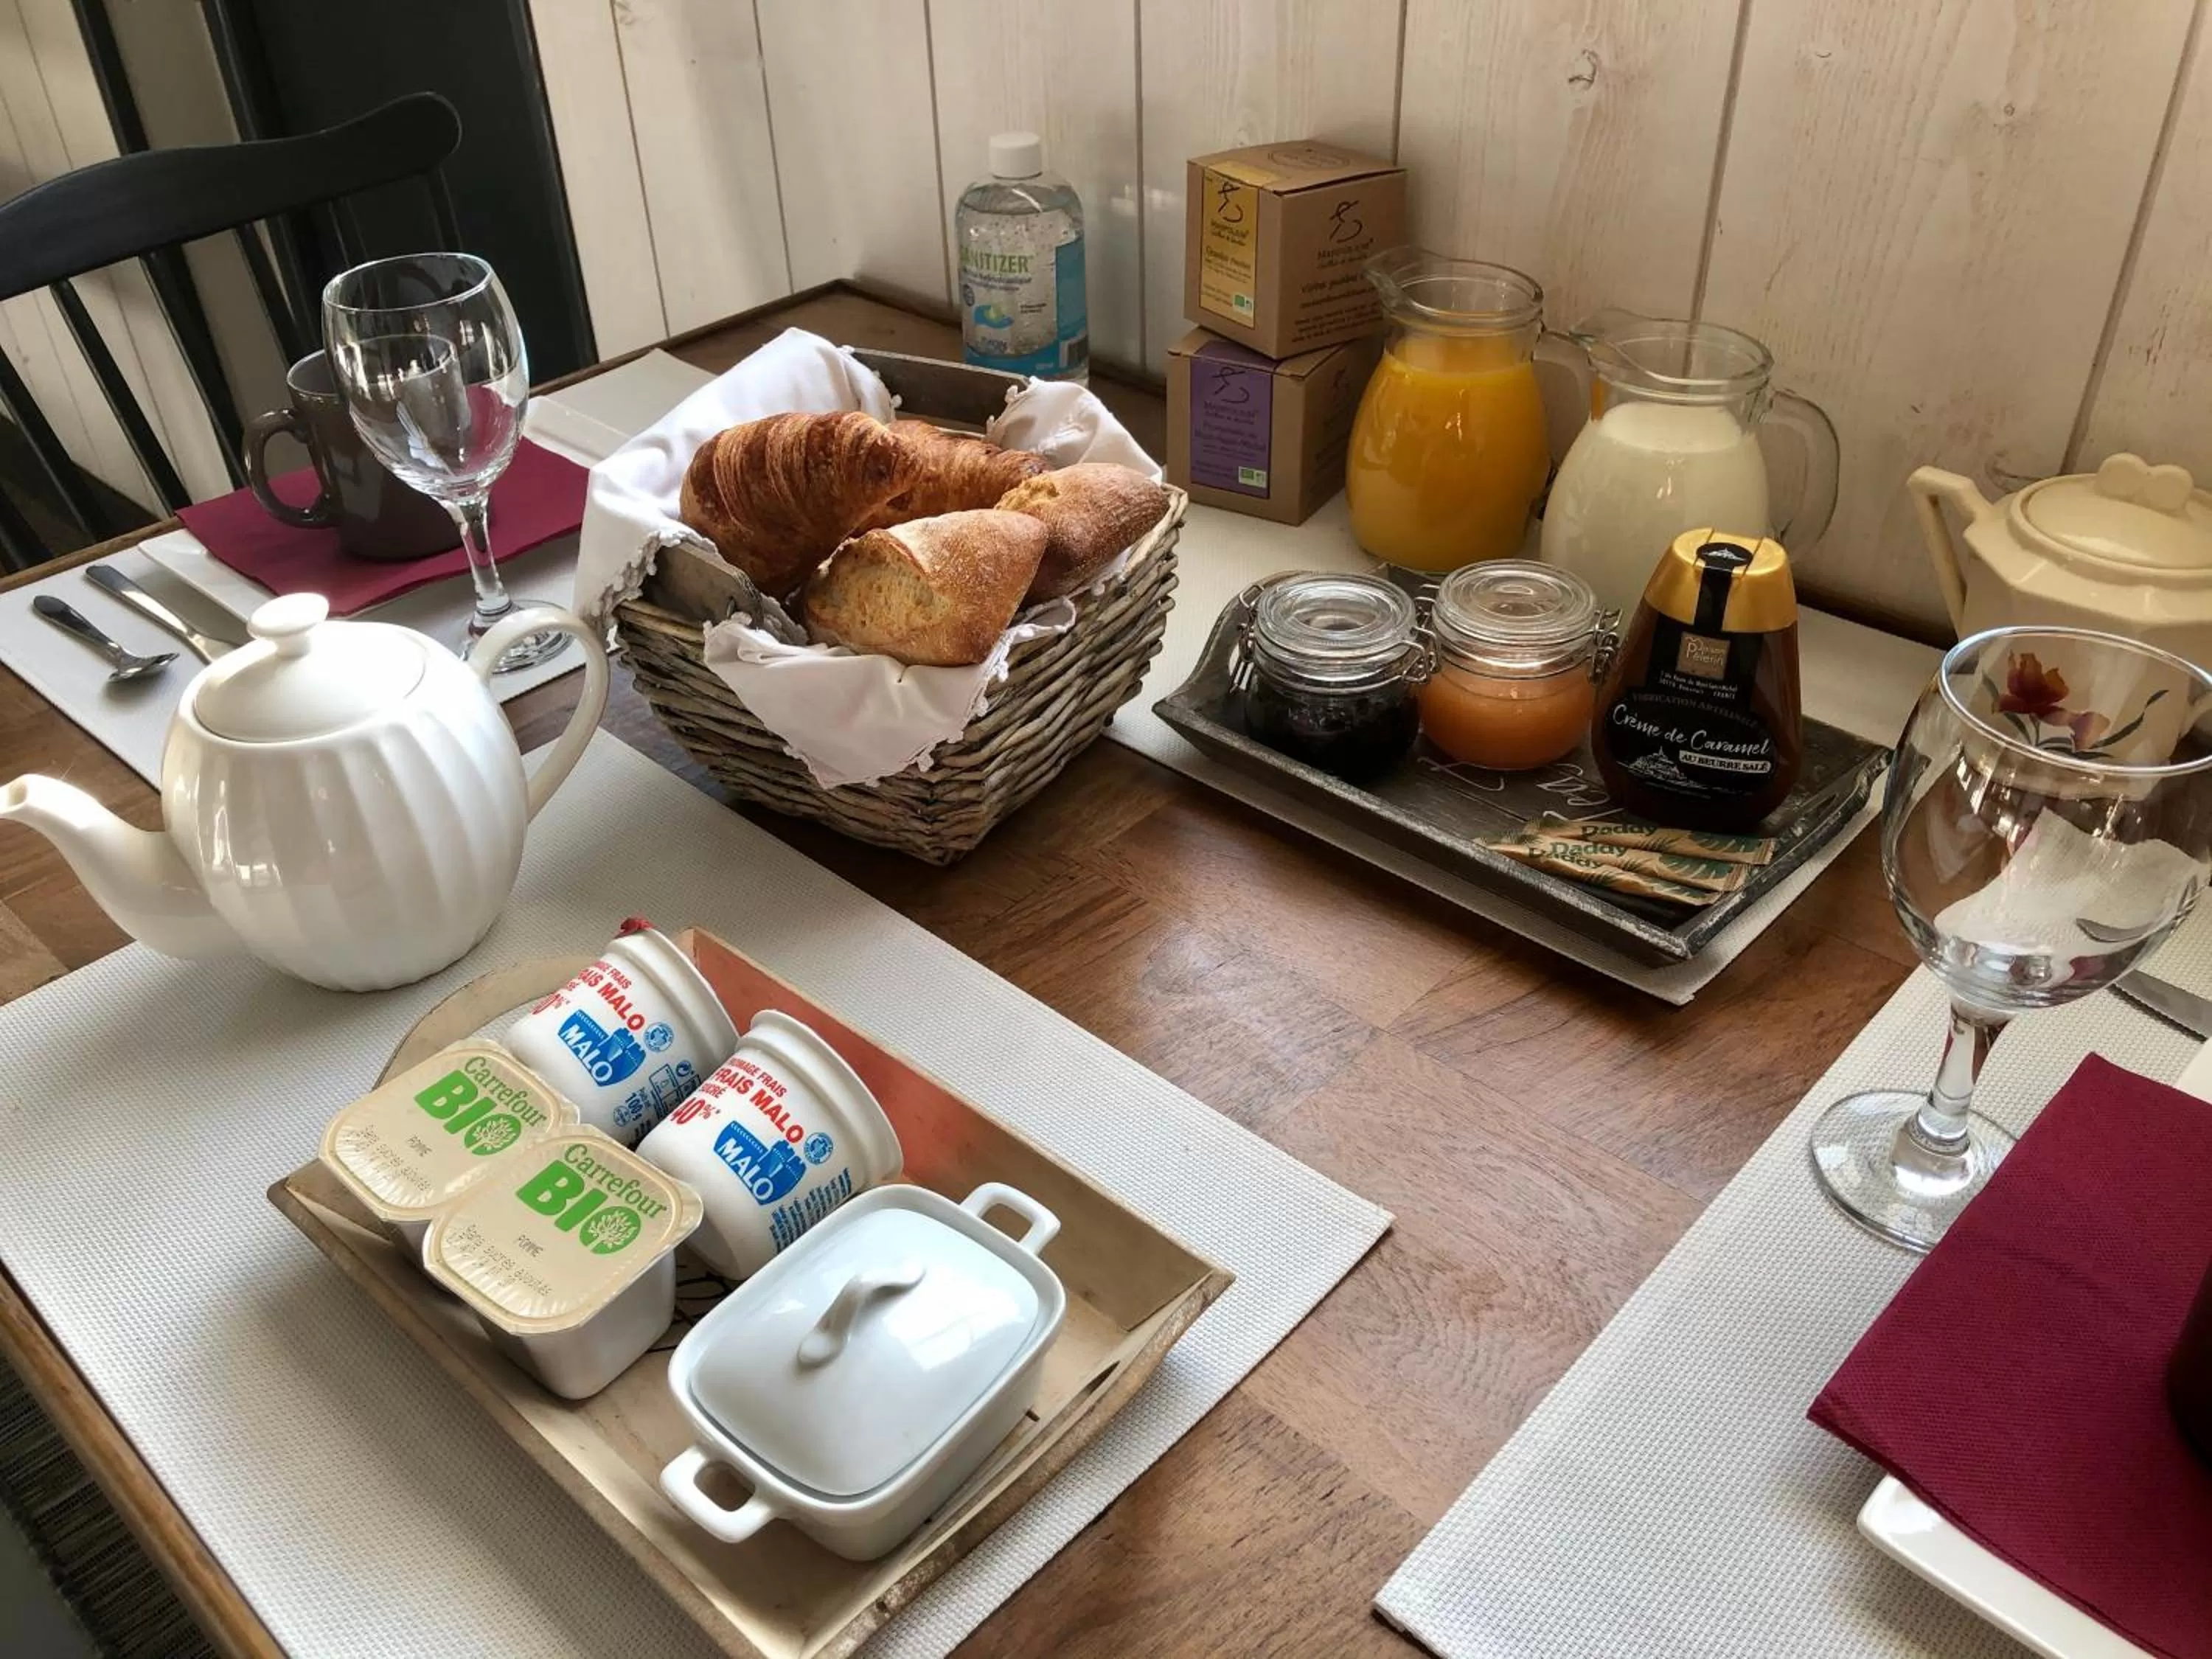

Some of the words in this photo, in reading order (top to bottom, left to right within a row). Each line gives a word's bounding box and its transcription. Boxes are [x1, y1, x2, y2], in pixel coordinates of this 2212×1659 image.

[1613, 704, 1662, 737] Crème
[1664, 728, 1687, 743] de
[1690, 729, 1770, 756] Caramel
[1681, 754, 1696, 762] AU
[1698, 756, 1740, 771] BEURRE
[1742, 760, 1769, 772] SALÉ
[1550, 841, 1627, 857] Daddy
[1580, 824, 1658, 837] Daddy
[597, 982, 645, 1031] MALO
[608, 968, 632, 990] FRAIS
[560, 1024, 613, 1082] MALO
[413, 1069, 522, 1156] BIO
[465, 1056, 548, 1127] Carrefour
[714, 1067, 754, 1095] FRAIS
[750, 1088, 804, 1144] MALO
[757, 1072, 787, 1098] FRAIS
[564, 1144, 667, 1219] Carrefour
[717, 1136, 773, 1201] MALO
[515, 1159, 641, 1255] BIO
